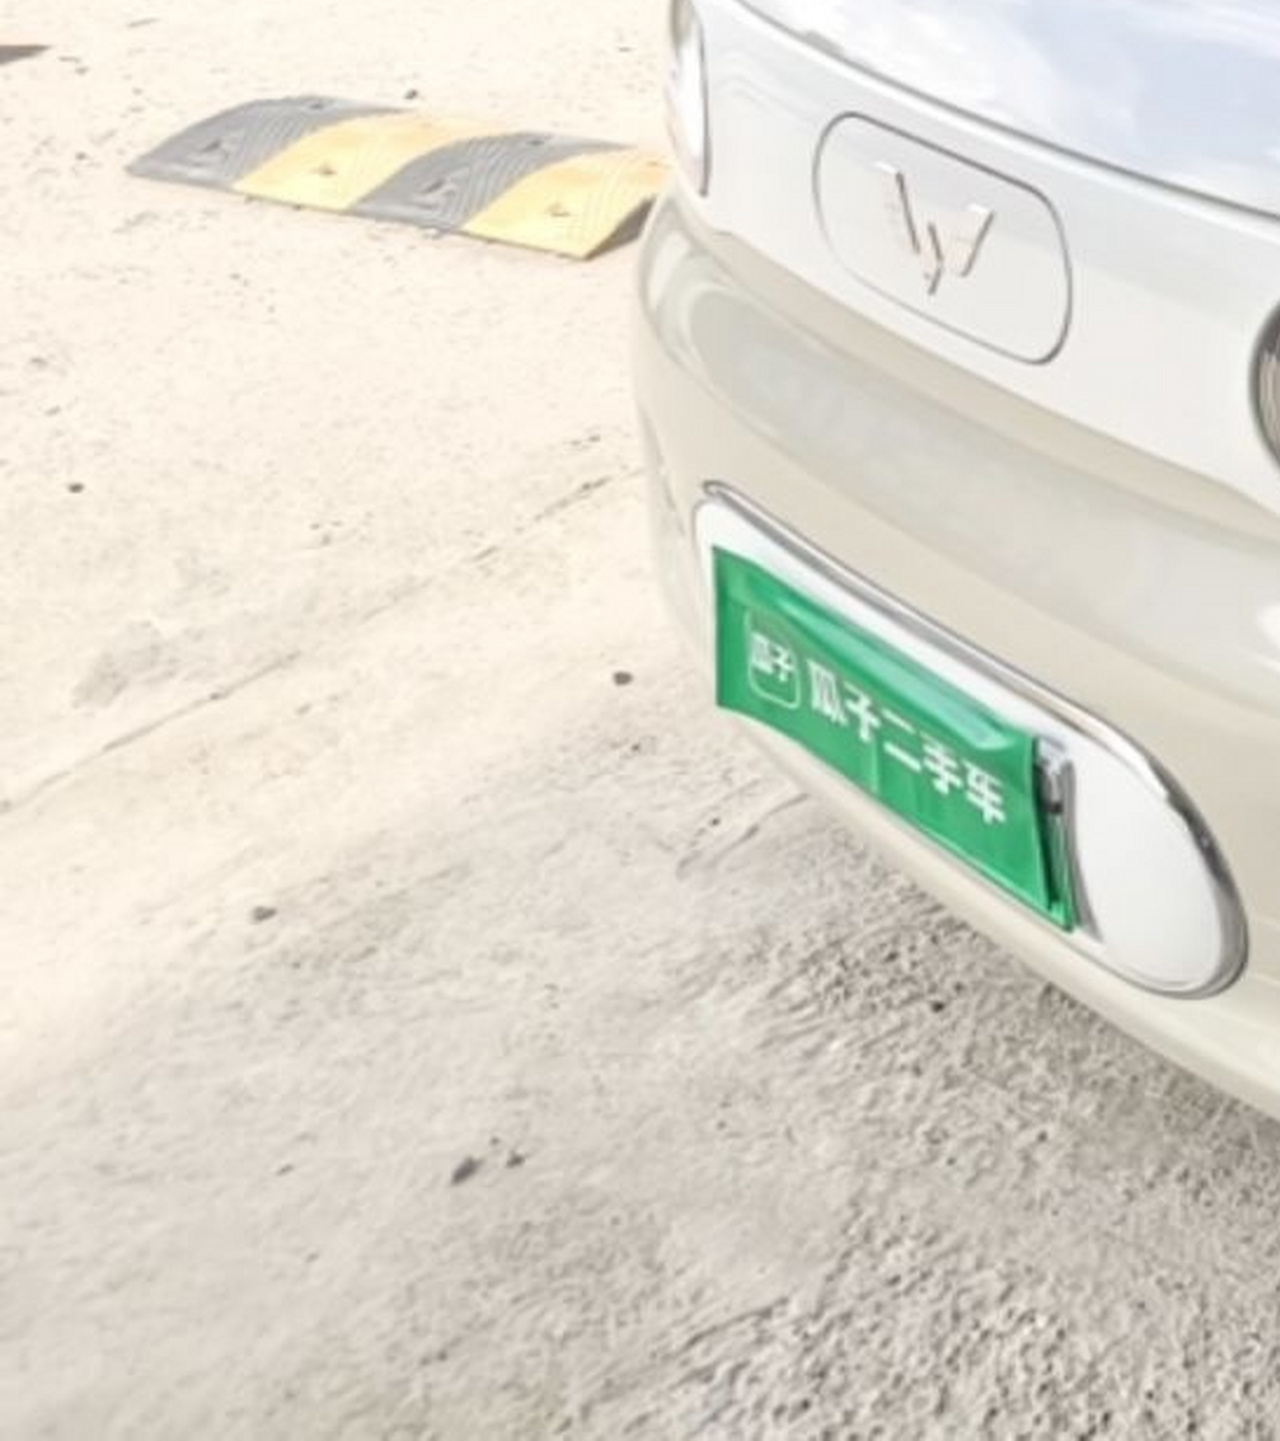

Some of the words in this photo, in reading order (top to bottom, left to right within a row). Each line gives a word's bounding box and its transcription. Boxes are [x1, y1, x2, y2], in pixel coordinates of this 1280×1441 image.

[806, 657, 1007, 826] 瓜子二手车
